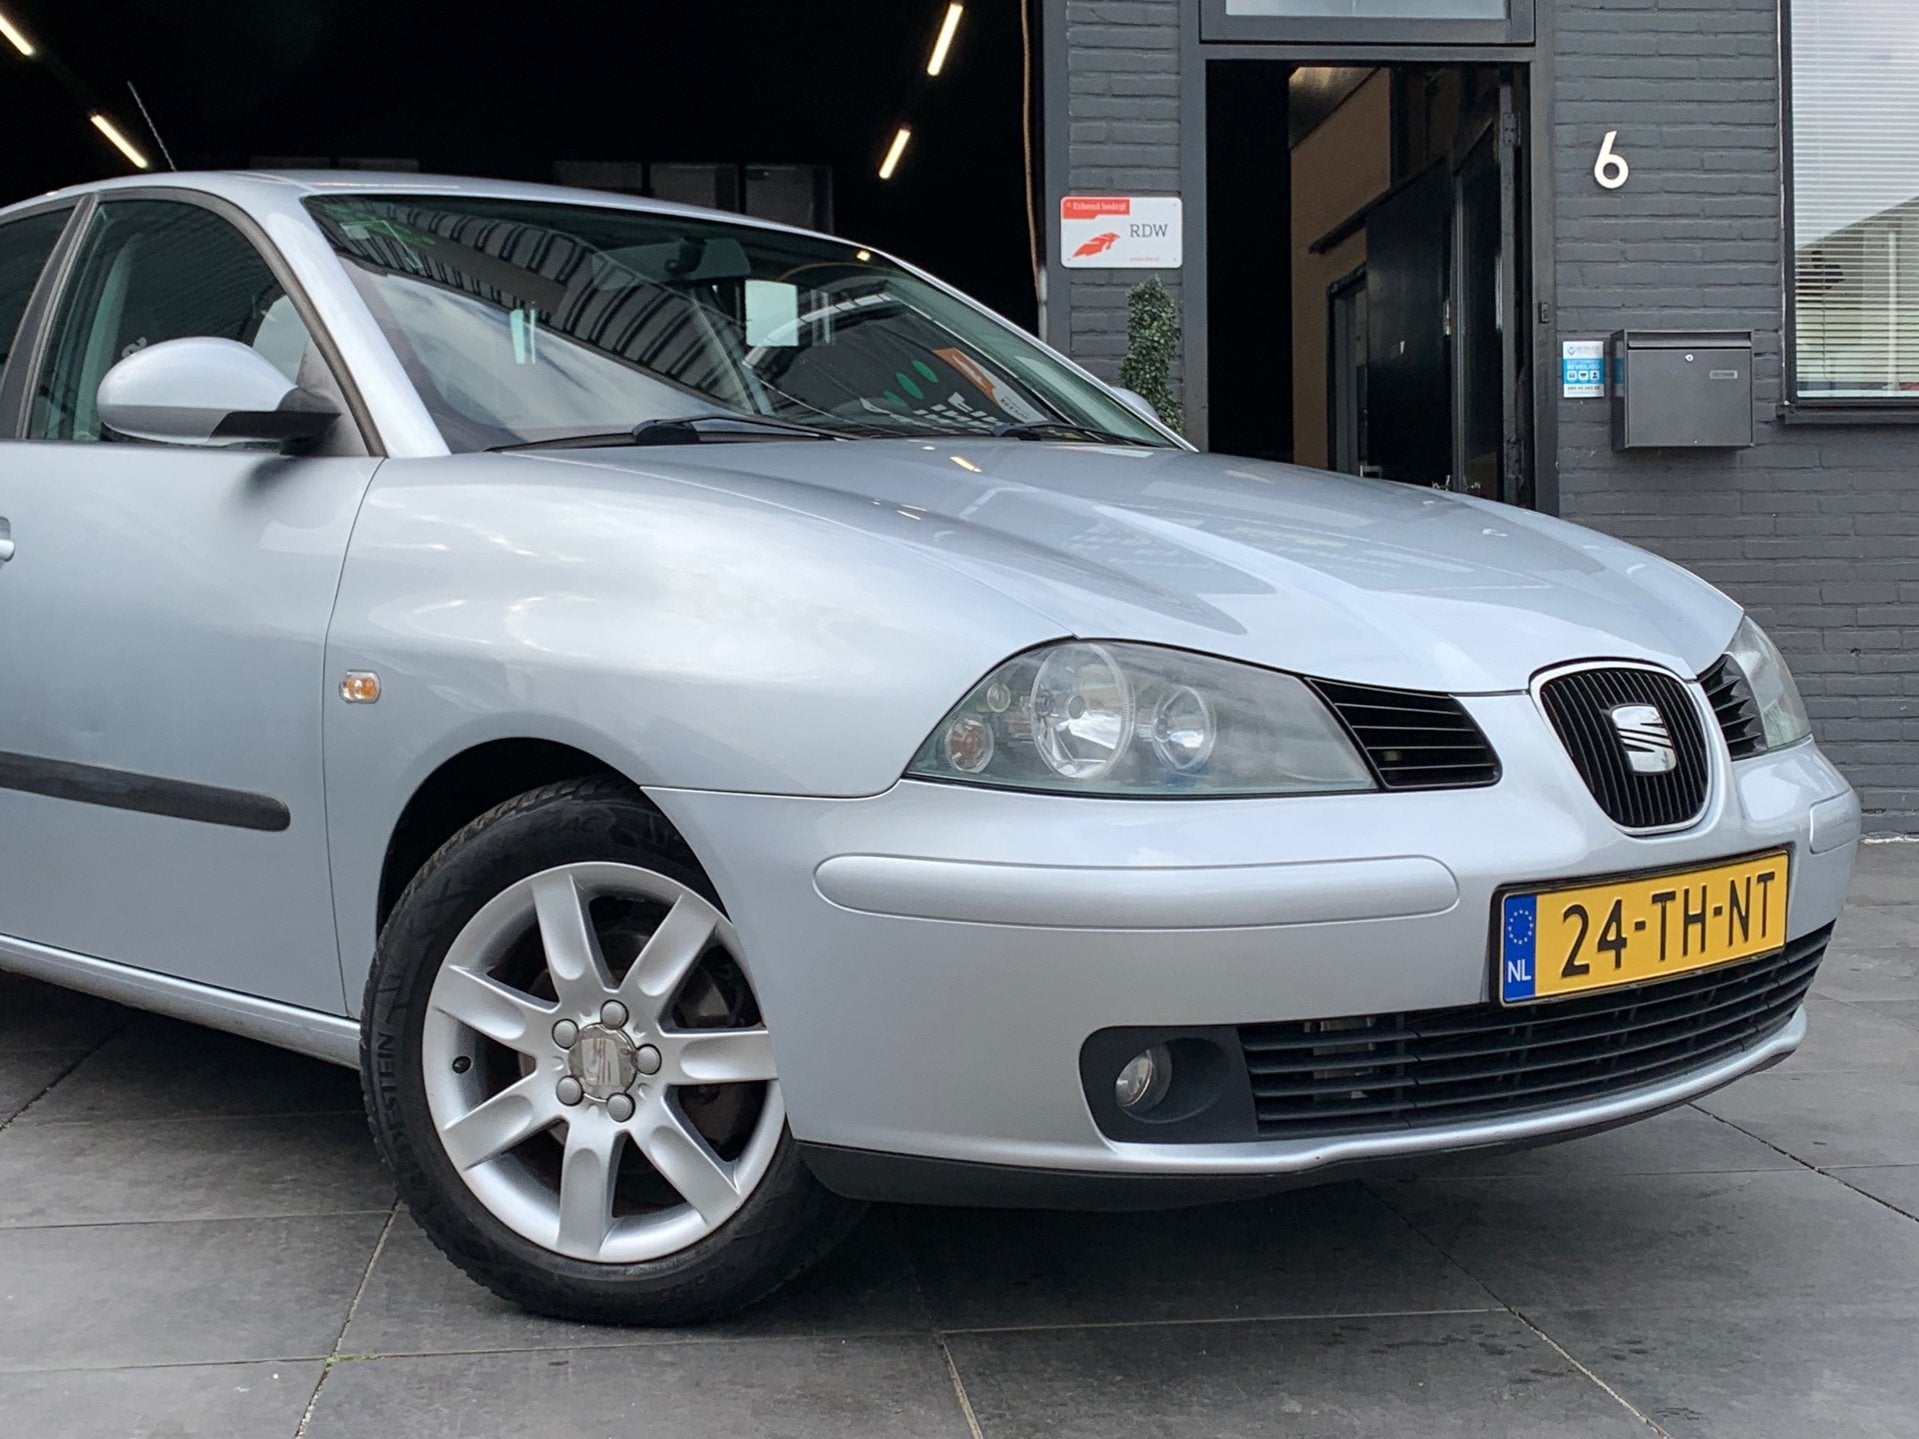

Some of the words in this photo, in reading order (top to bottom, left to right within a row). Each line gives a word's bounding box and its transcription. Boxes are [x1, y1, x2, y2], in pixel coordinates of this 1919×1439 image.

[1594, 130, 1629, 189] 6
[1073, 201, 1100, 211] Erkend
[1101, 201, 1127, 212] bedrijf
[1129, 224, 1168, 238] RDW
[1561, 871, 1775, 979] 24-TH-NT
[1507, 960, 1532, 984] NL
